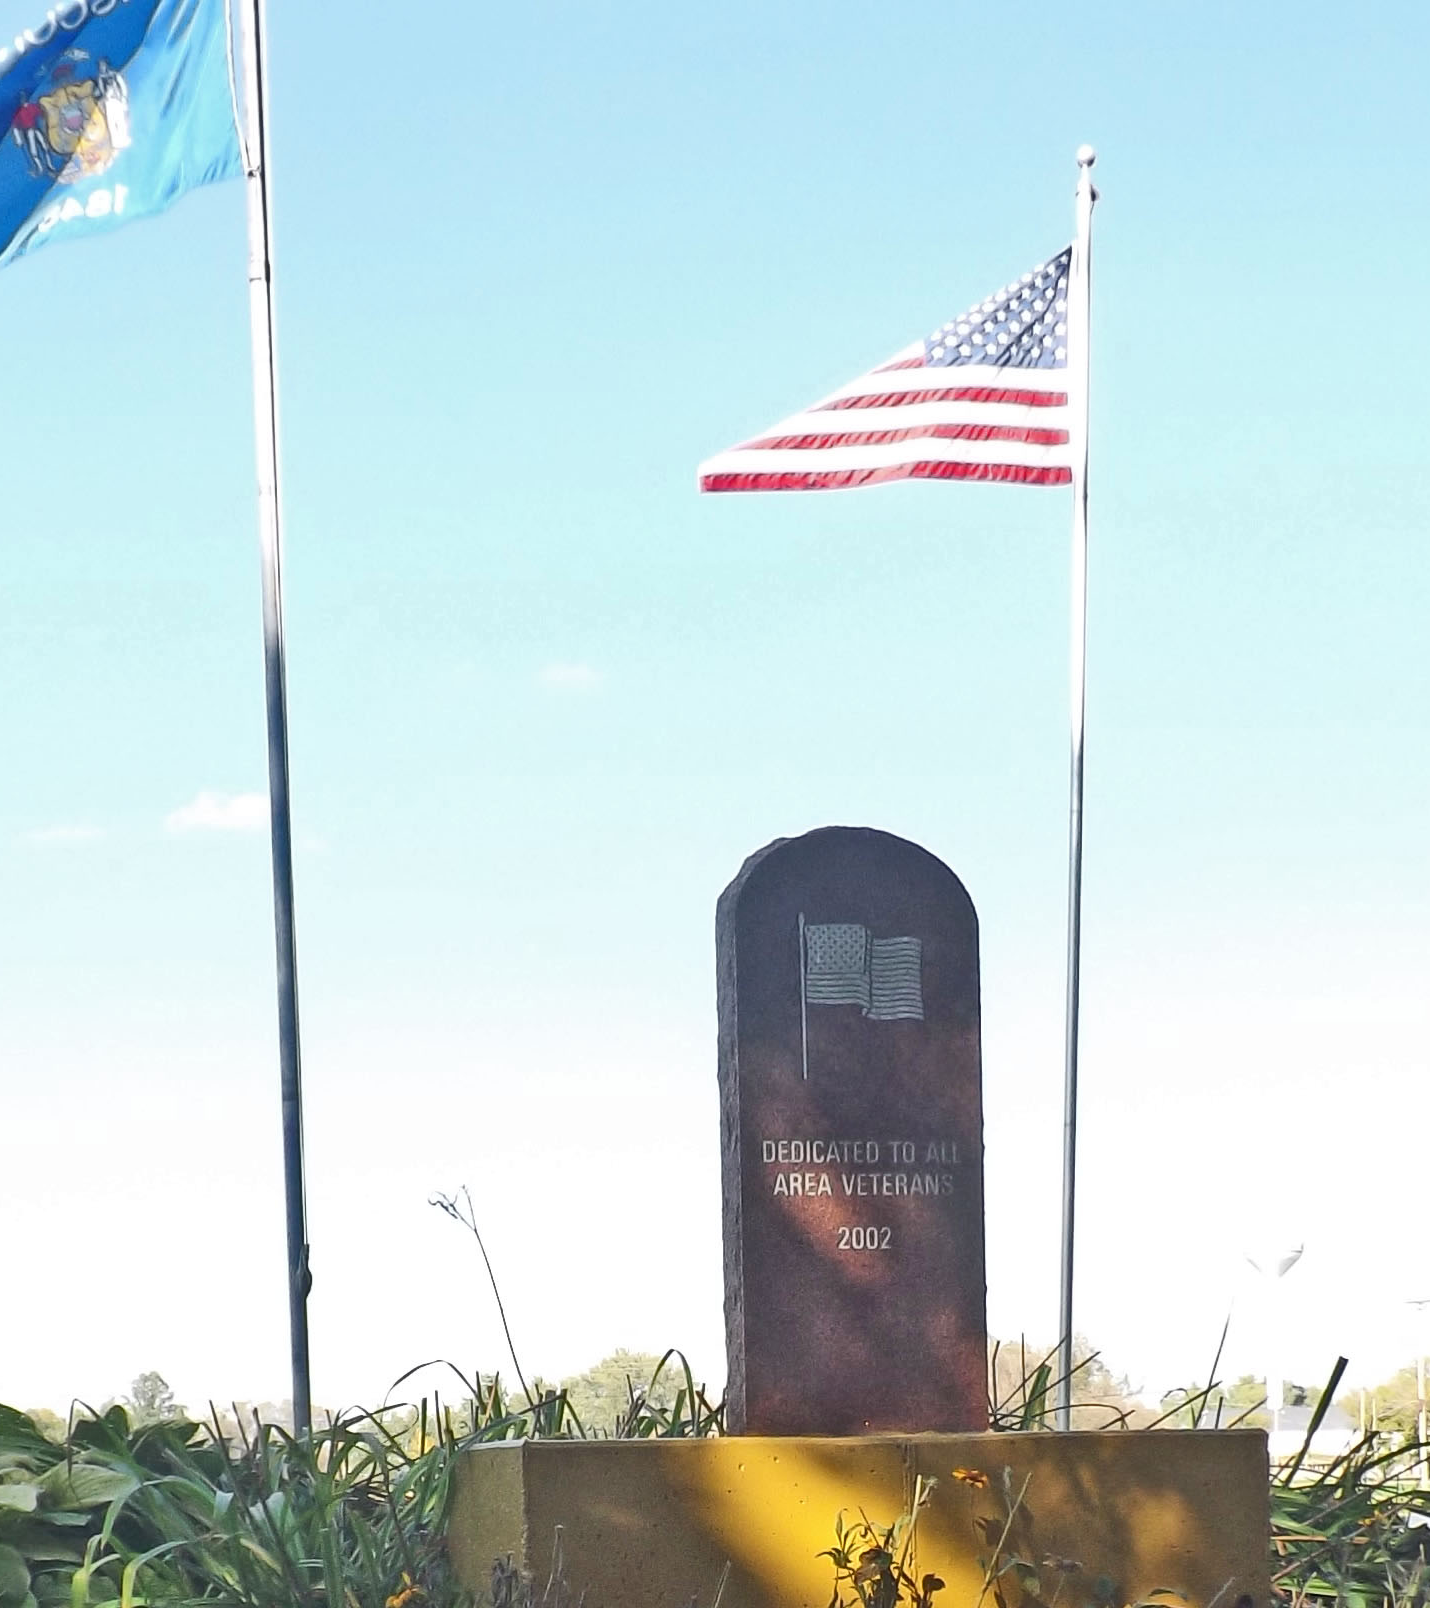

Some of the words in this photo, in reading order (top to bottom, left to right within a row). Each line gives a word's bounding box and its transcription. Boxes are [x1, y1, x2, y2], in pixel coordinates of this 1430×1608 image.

[762, 1140, 880, 1164] DEDICATED
[891, 1141, 916, 1164] TO
[926, 1141, 962, 1164] ALL
[772, 1173, 833, 1197] AREA
[841, 1173, 955, 1197] VETERANS
[837, 1226, 892, 1251] 2002
